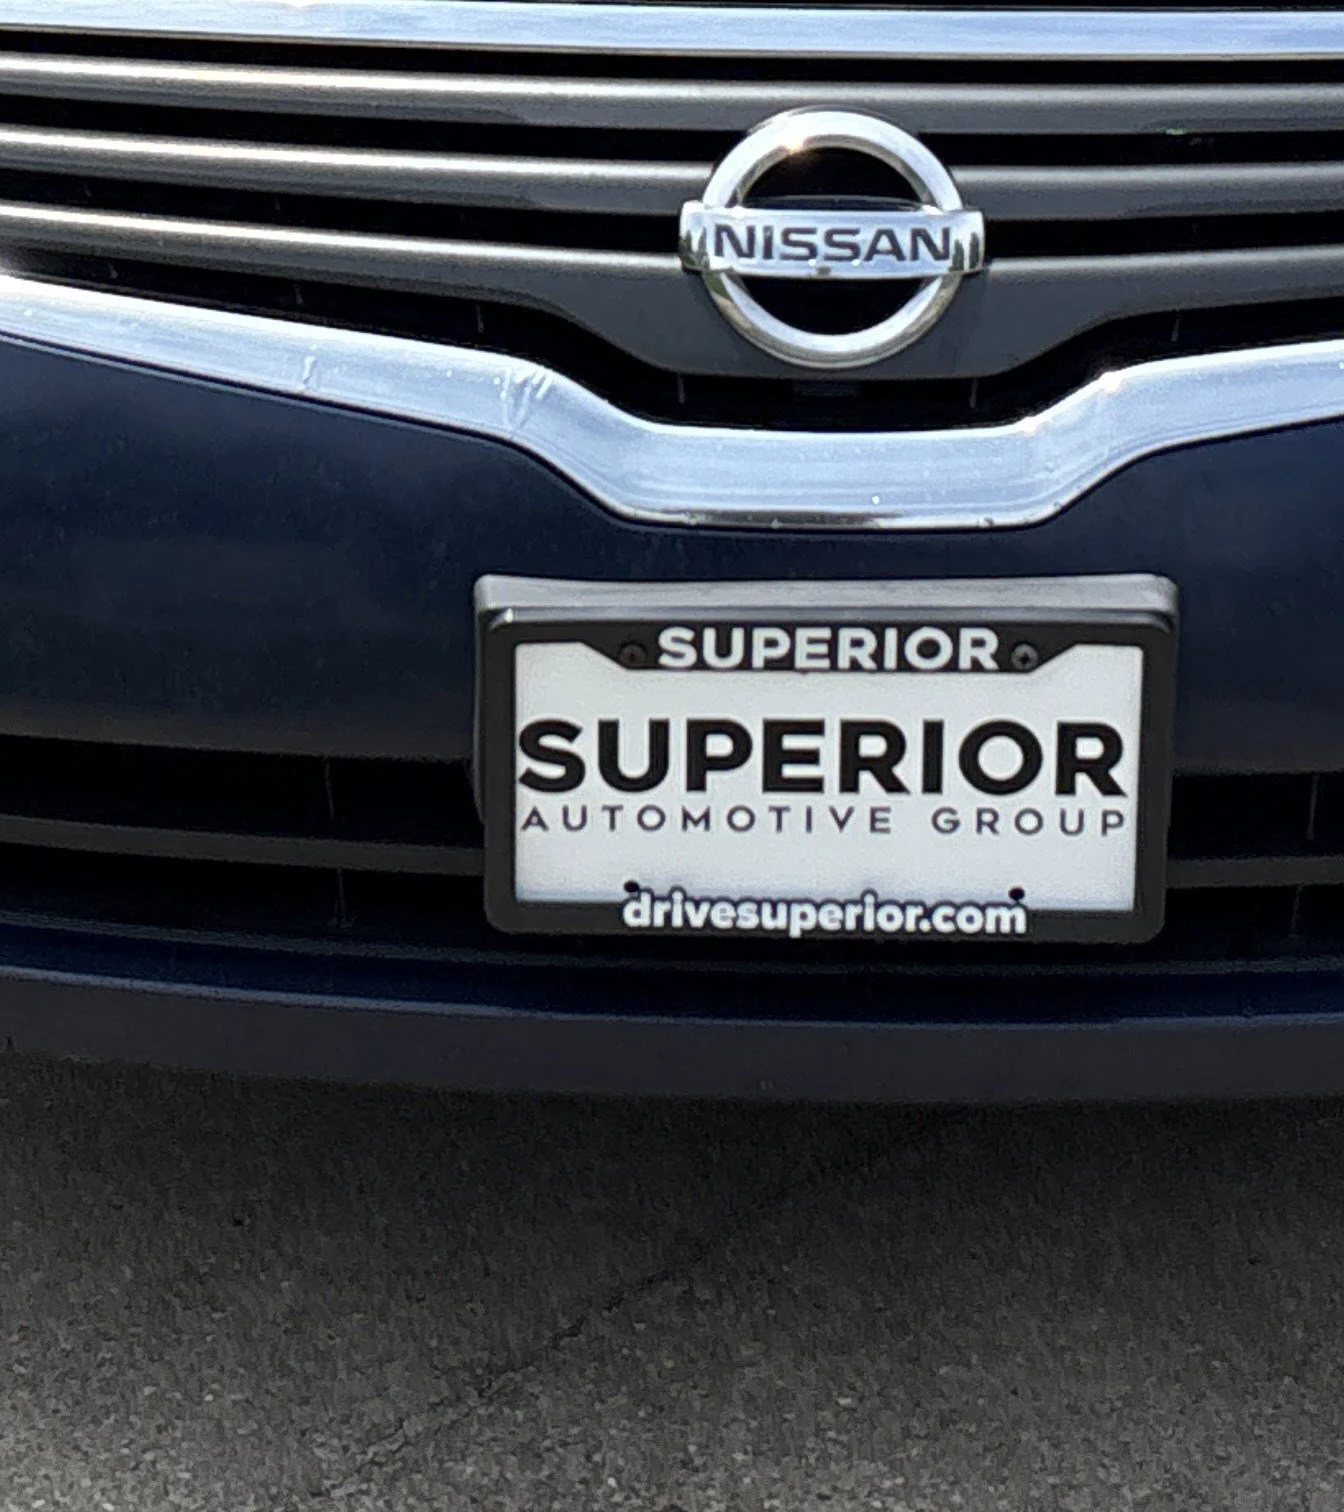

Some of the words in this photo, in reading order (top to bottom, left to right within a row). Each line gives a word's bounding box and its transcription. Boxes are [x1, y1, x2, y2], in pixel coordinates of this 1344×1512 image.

[714, 223, 950, 262] NISSAN
[657, 626, 1000, 671] SUPERIOR
[517, 718, 1129, 797] SUPERIOR
[520, 803, 894, 835] AUTOMOTIVE
[931, 805, 1126, 837] GROUP
[622, 889, 1028, 937] drivesuperior.com
